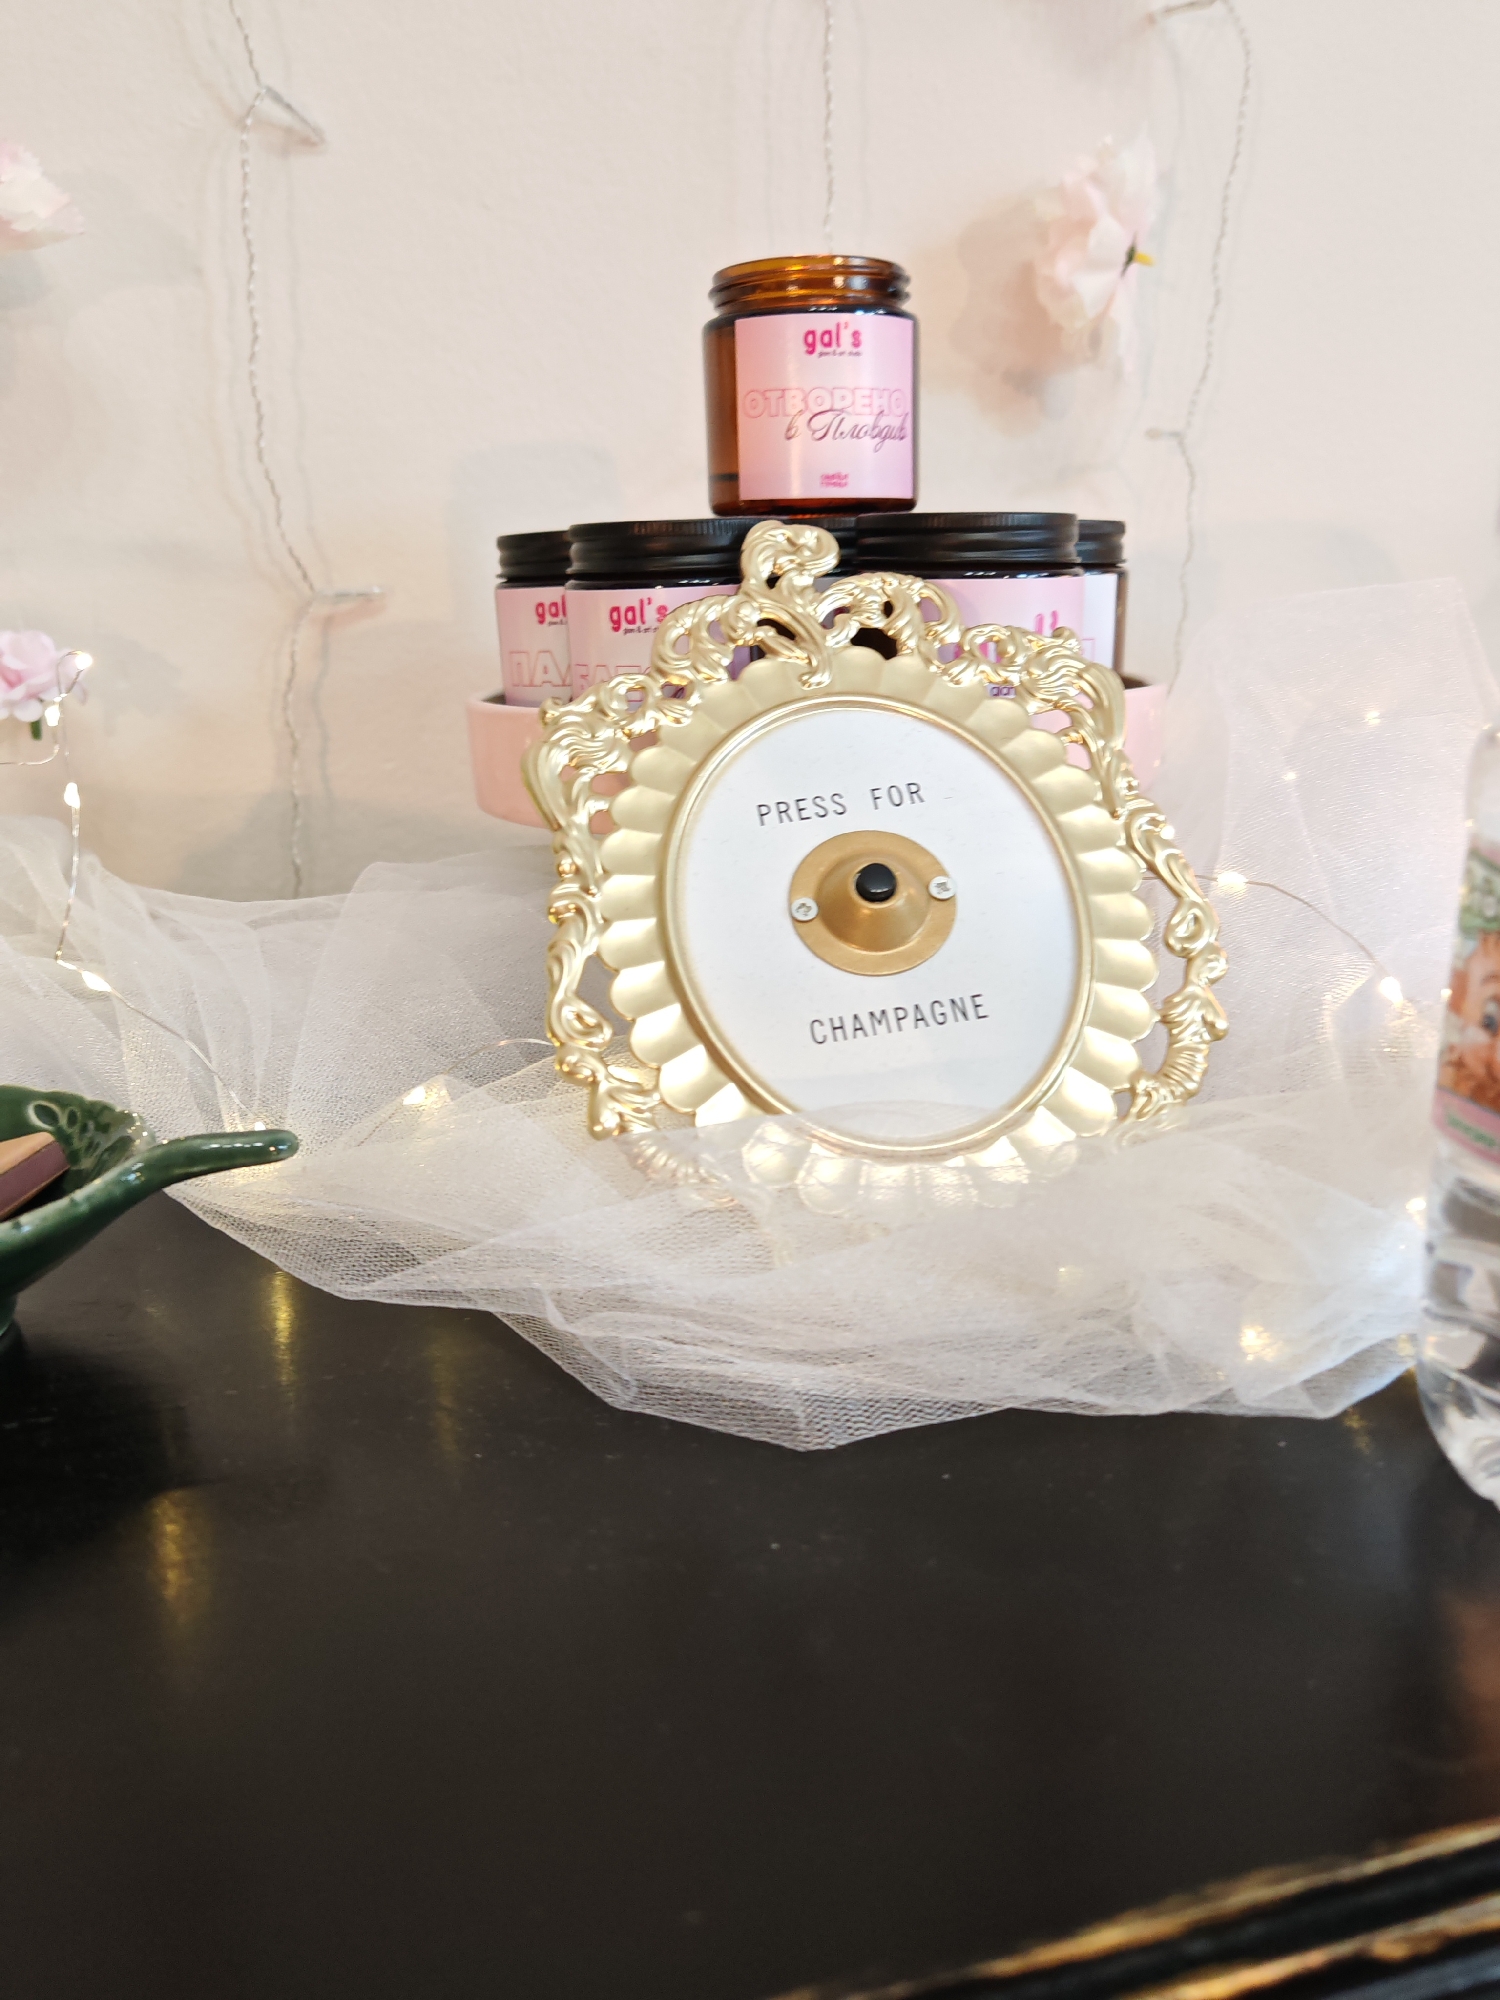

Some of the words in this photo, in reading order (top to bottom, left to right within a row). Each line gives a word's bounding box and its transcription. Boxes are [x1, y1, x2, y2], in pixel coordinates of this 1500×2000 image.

[804, 322, 863, 356] gal's
[743, 387, 908, 419] ОТВОРЕНО
[508, 649, 572, 688] ПА
[756, 792, 848, 827] PRESS
[869, 781, 926, 811] FOR
[809, 993, 990, 1046] CHAMPAGNE
